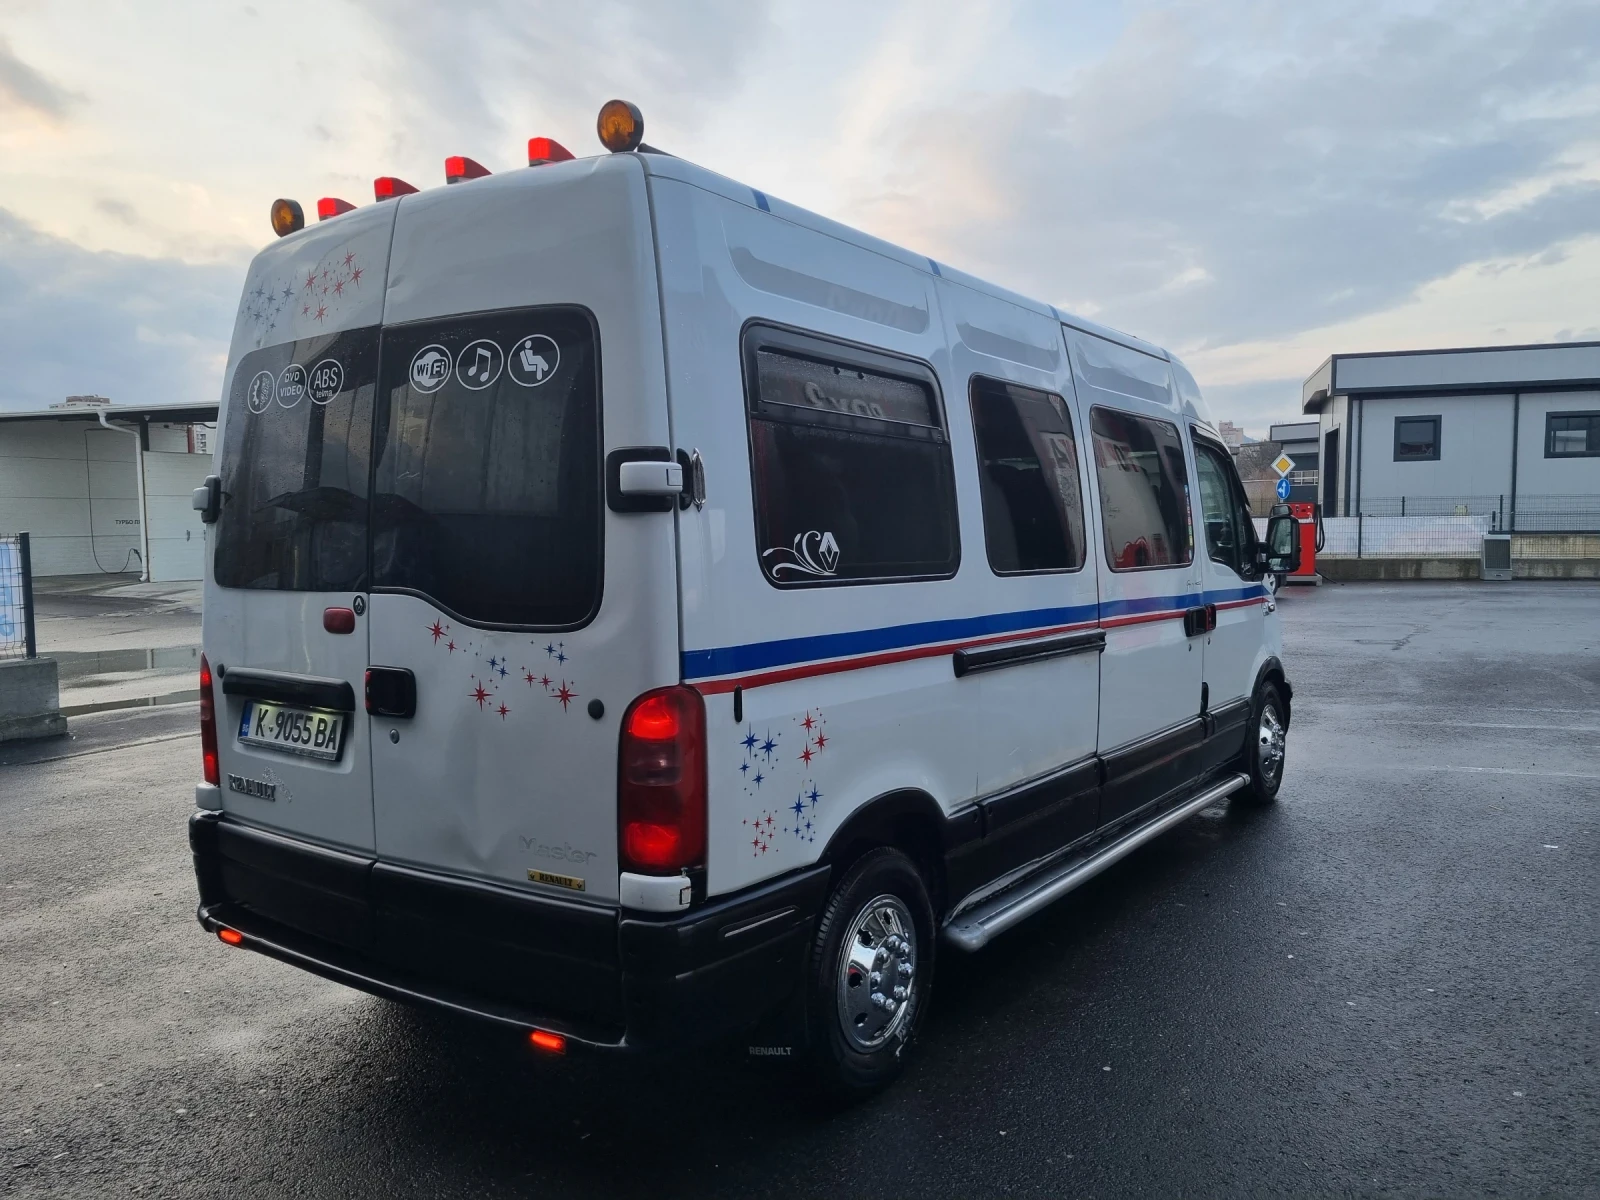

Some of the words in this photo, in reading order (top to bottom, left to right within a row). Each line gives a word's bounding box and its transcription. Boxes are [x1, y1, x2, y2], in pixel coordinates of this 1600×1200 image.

[284, 371, 300, 383] DVD
[313, 367, 339, 389] ABS
[280, 384, 302, 397] VIDEO
[539, 872, 573, 887] RENAULT
[748, 1046, 792, 1056] RENAULT
